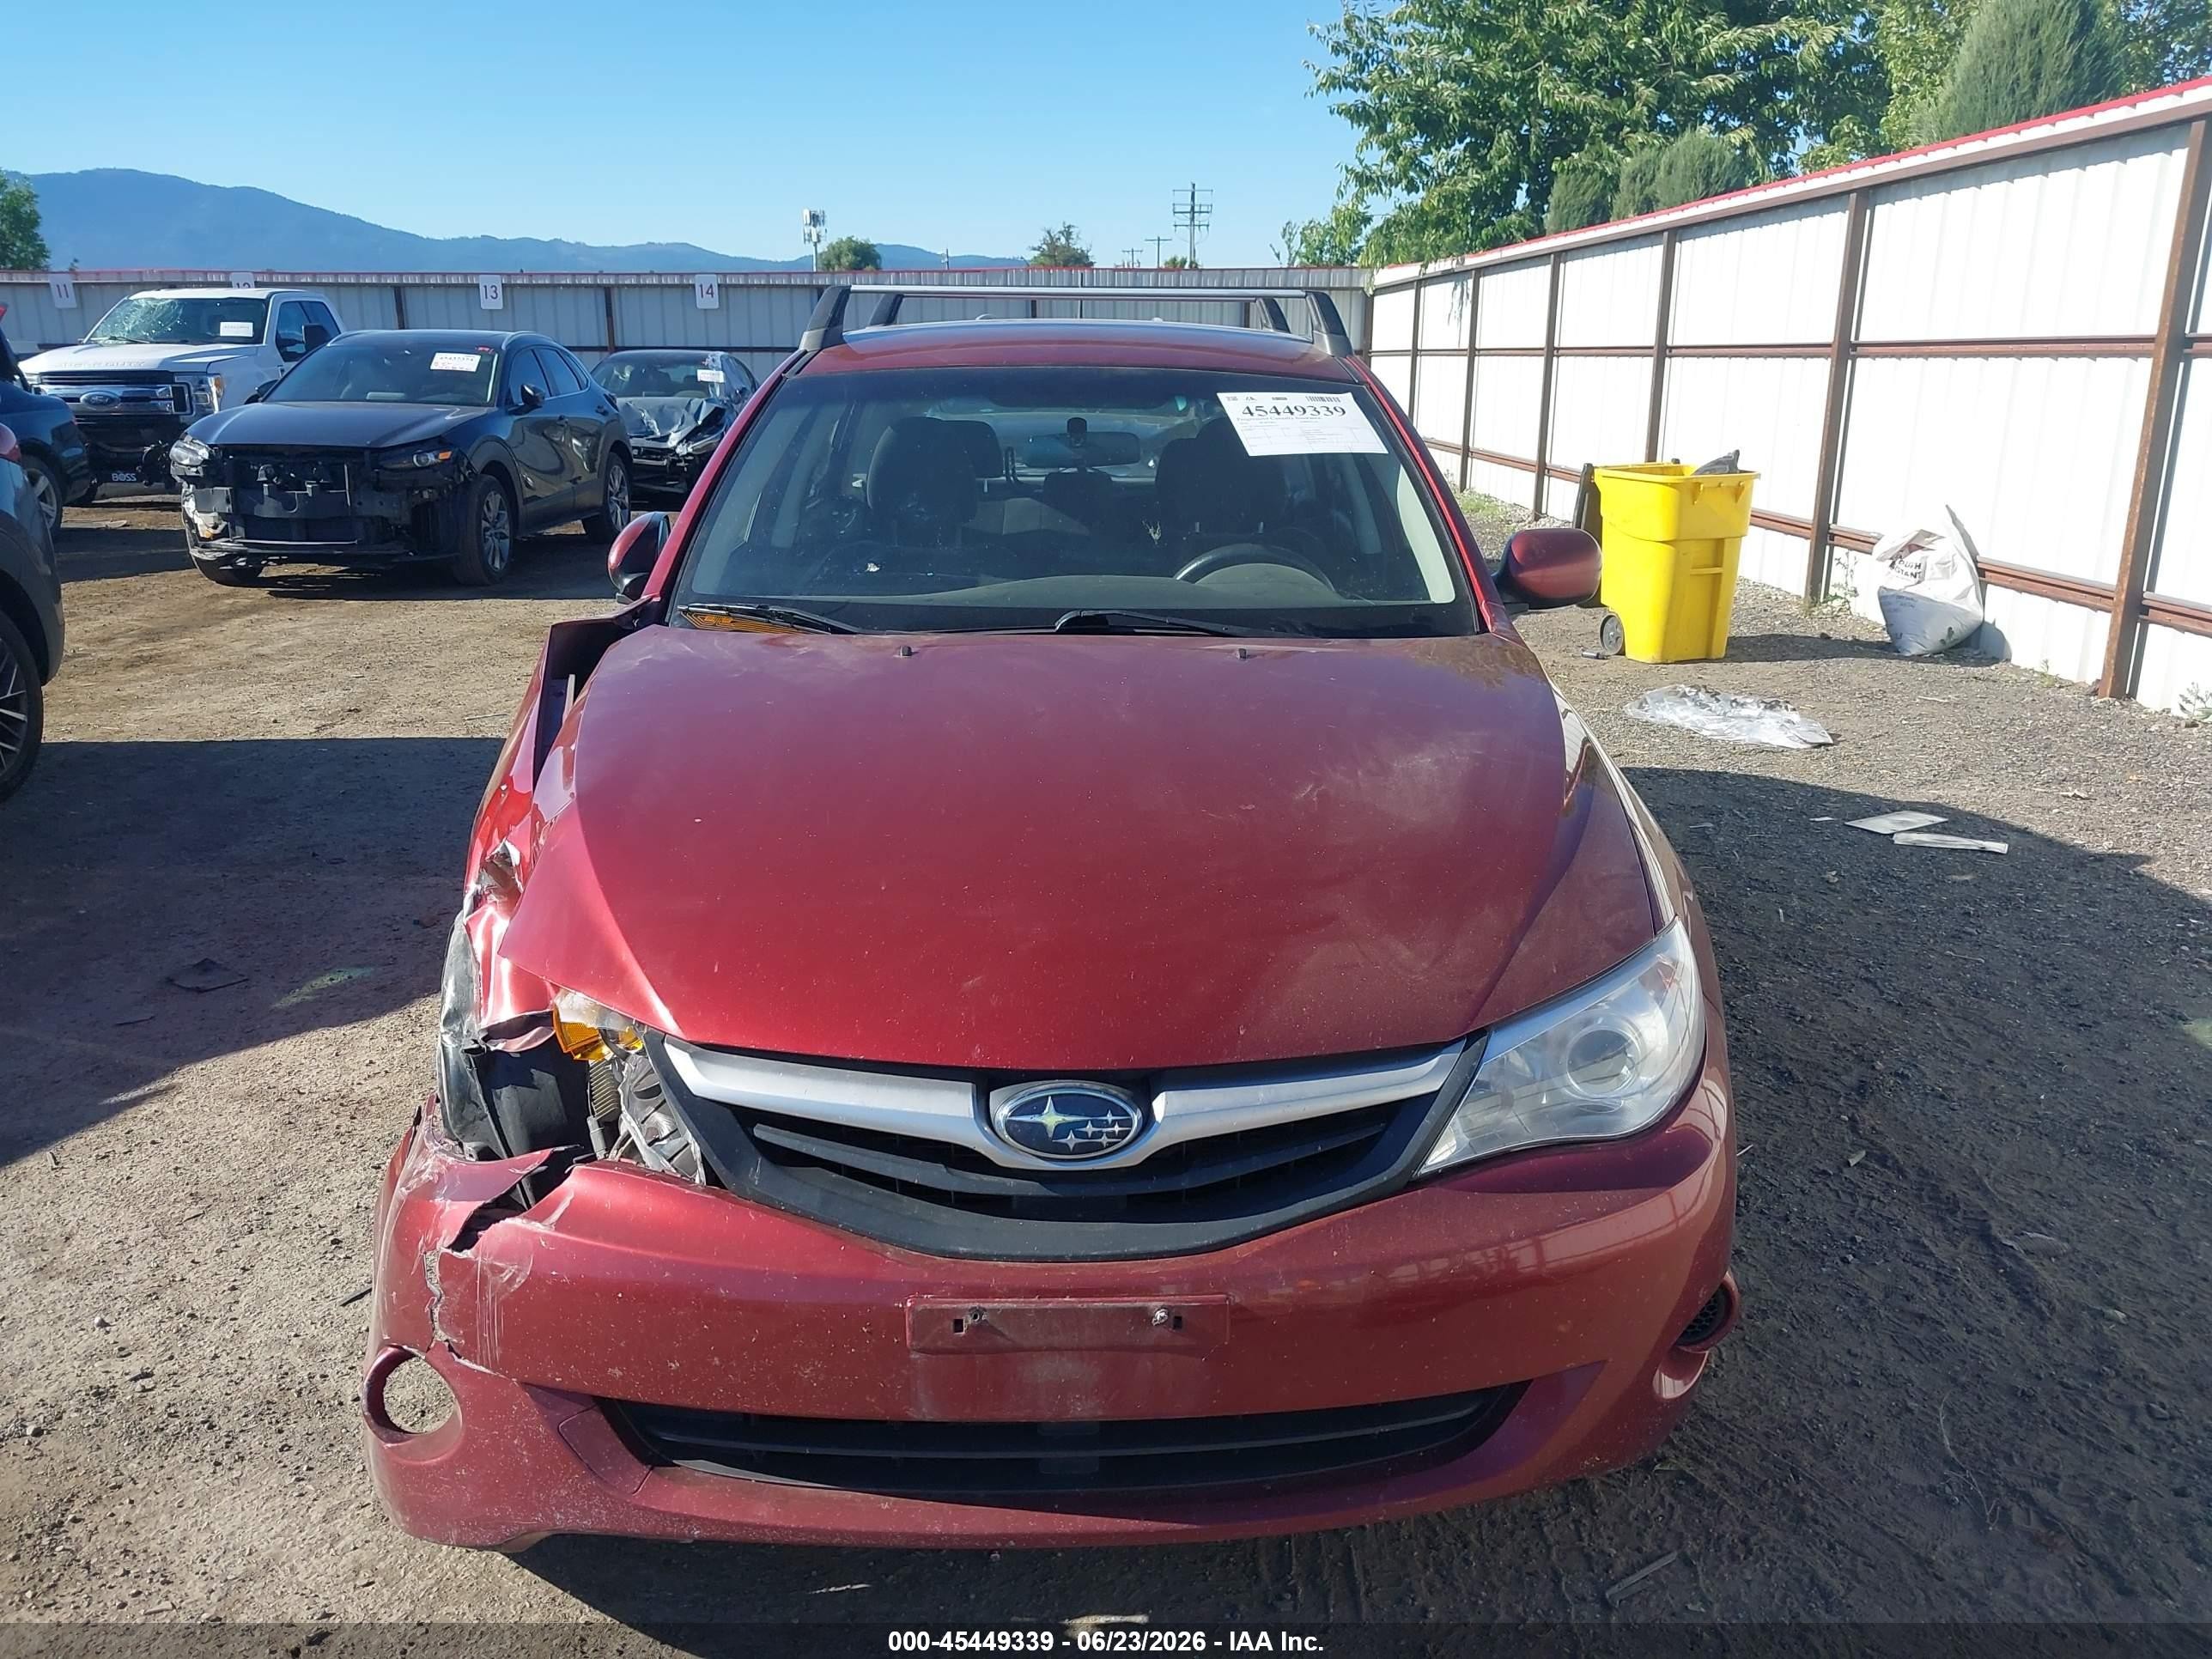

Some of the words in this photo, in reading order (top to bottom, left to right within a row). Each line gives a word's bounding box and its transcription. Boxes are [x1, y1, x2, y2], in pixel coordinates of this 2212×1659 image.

[56, 283, 70, 299] 11
[483, 284, 498, 300] 13
[699, 283, 714, 299] 14
[1242, 405, 1346, 417] 45449339
[112, 472, 137, 482] BOSS
